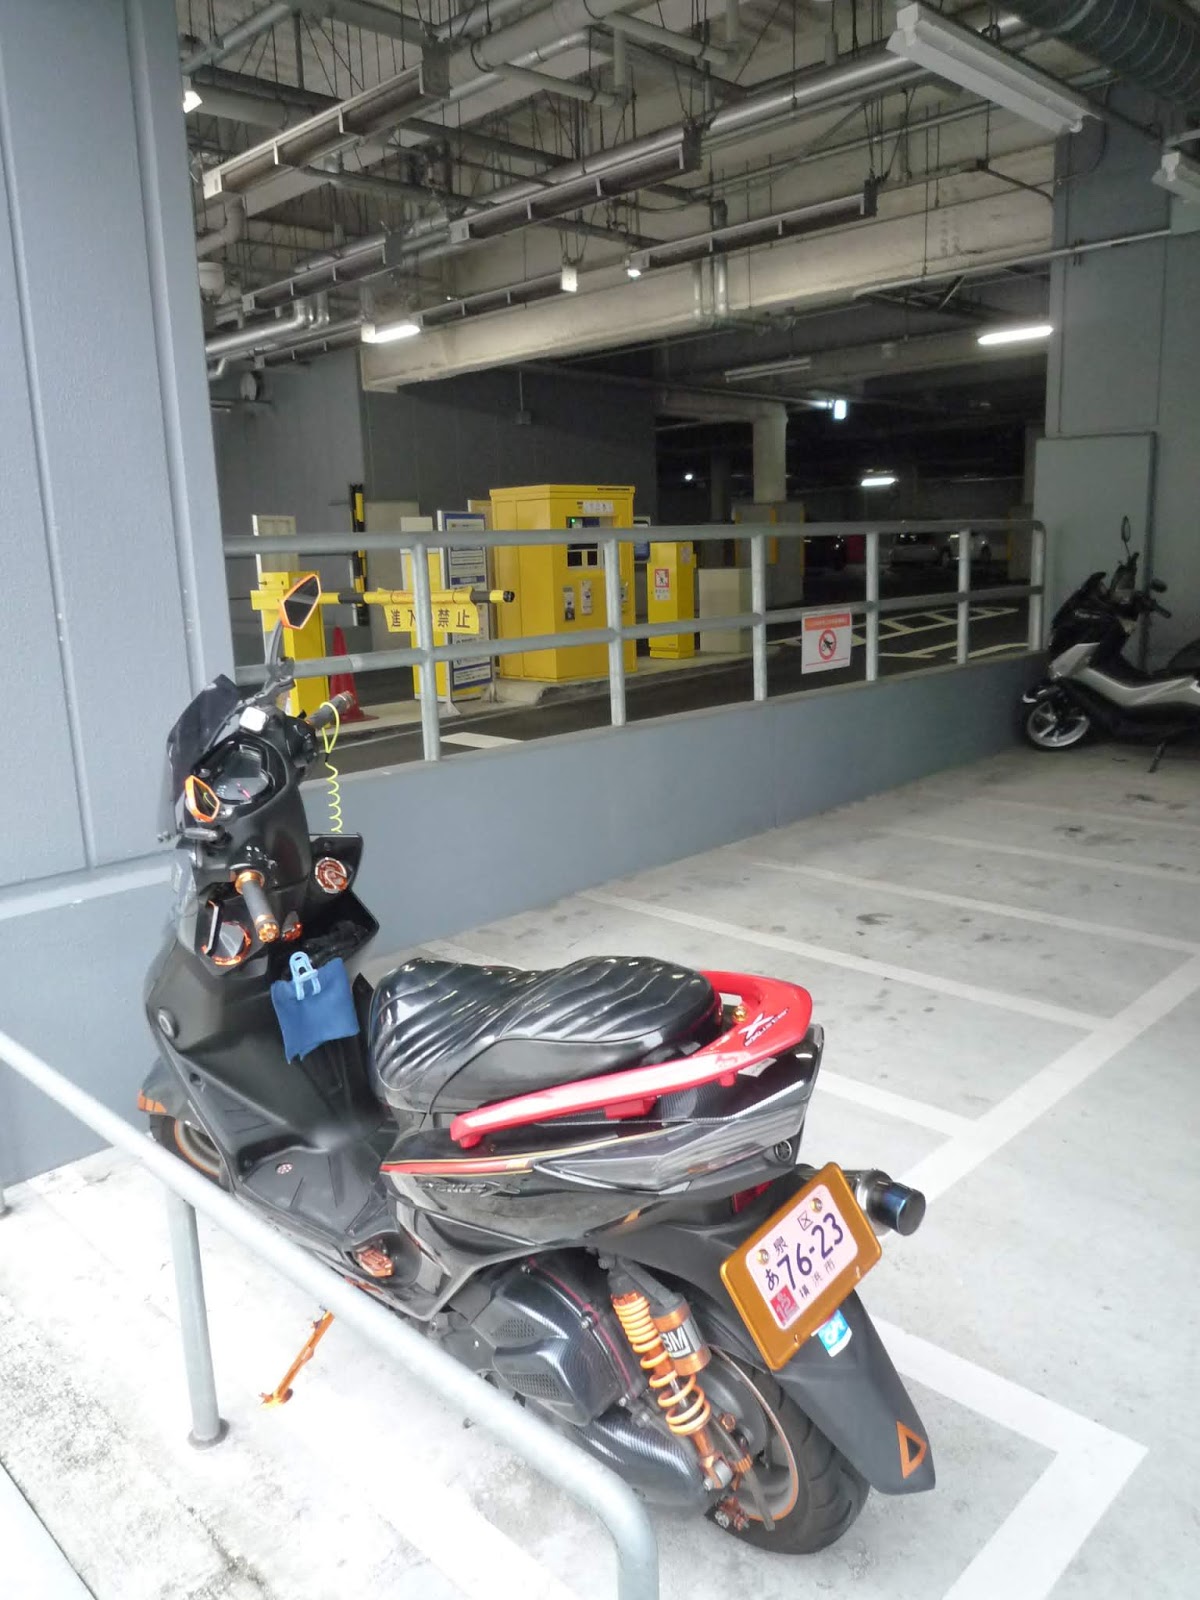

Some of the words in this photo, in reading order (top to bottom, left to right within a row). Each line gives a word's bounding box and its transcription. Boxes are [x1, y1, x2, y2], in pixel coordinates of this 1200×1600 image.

[765, 1268, 780, 1291] あ
[777, 1212, 844, 1290] 76-23
[773, 1210, 814, 1257] 泉区
[799, 1260, 836, 1299] 横浜市
